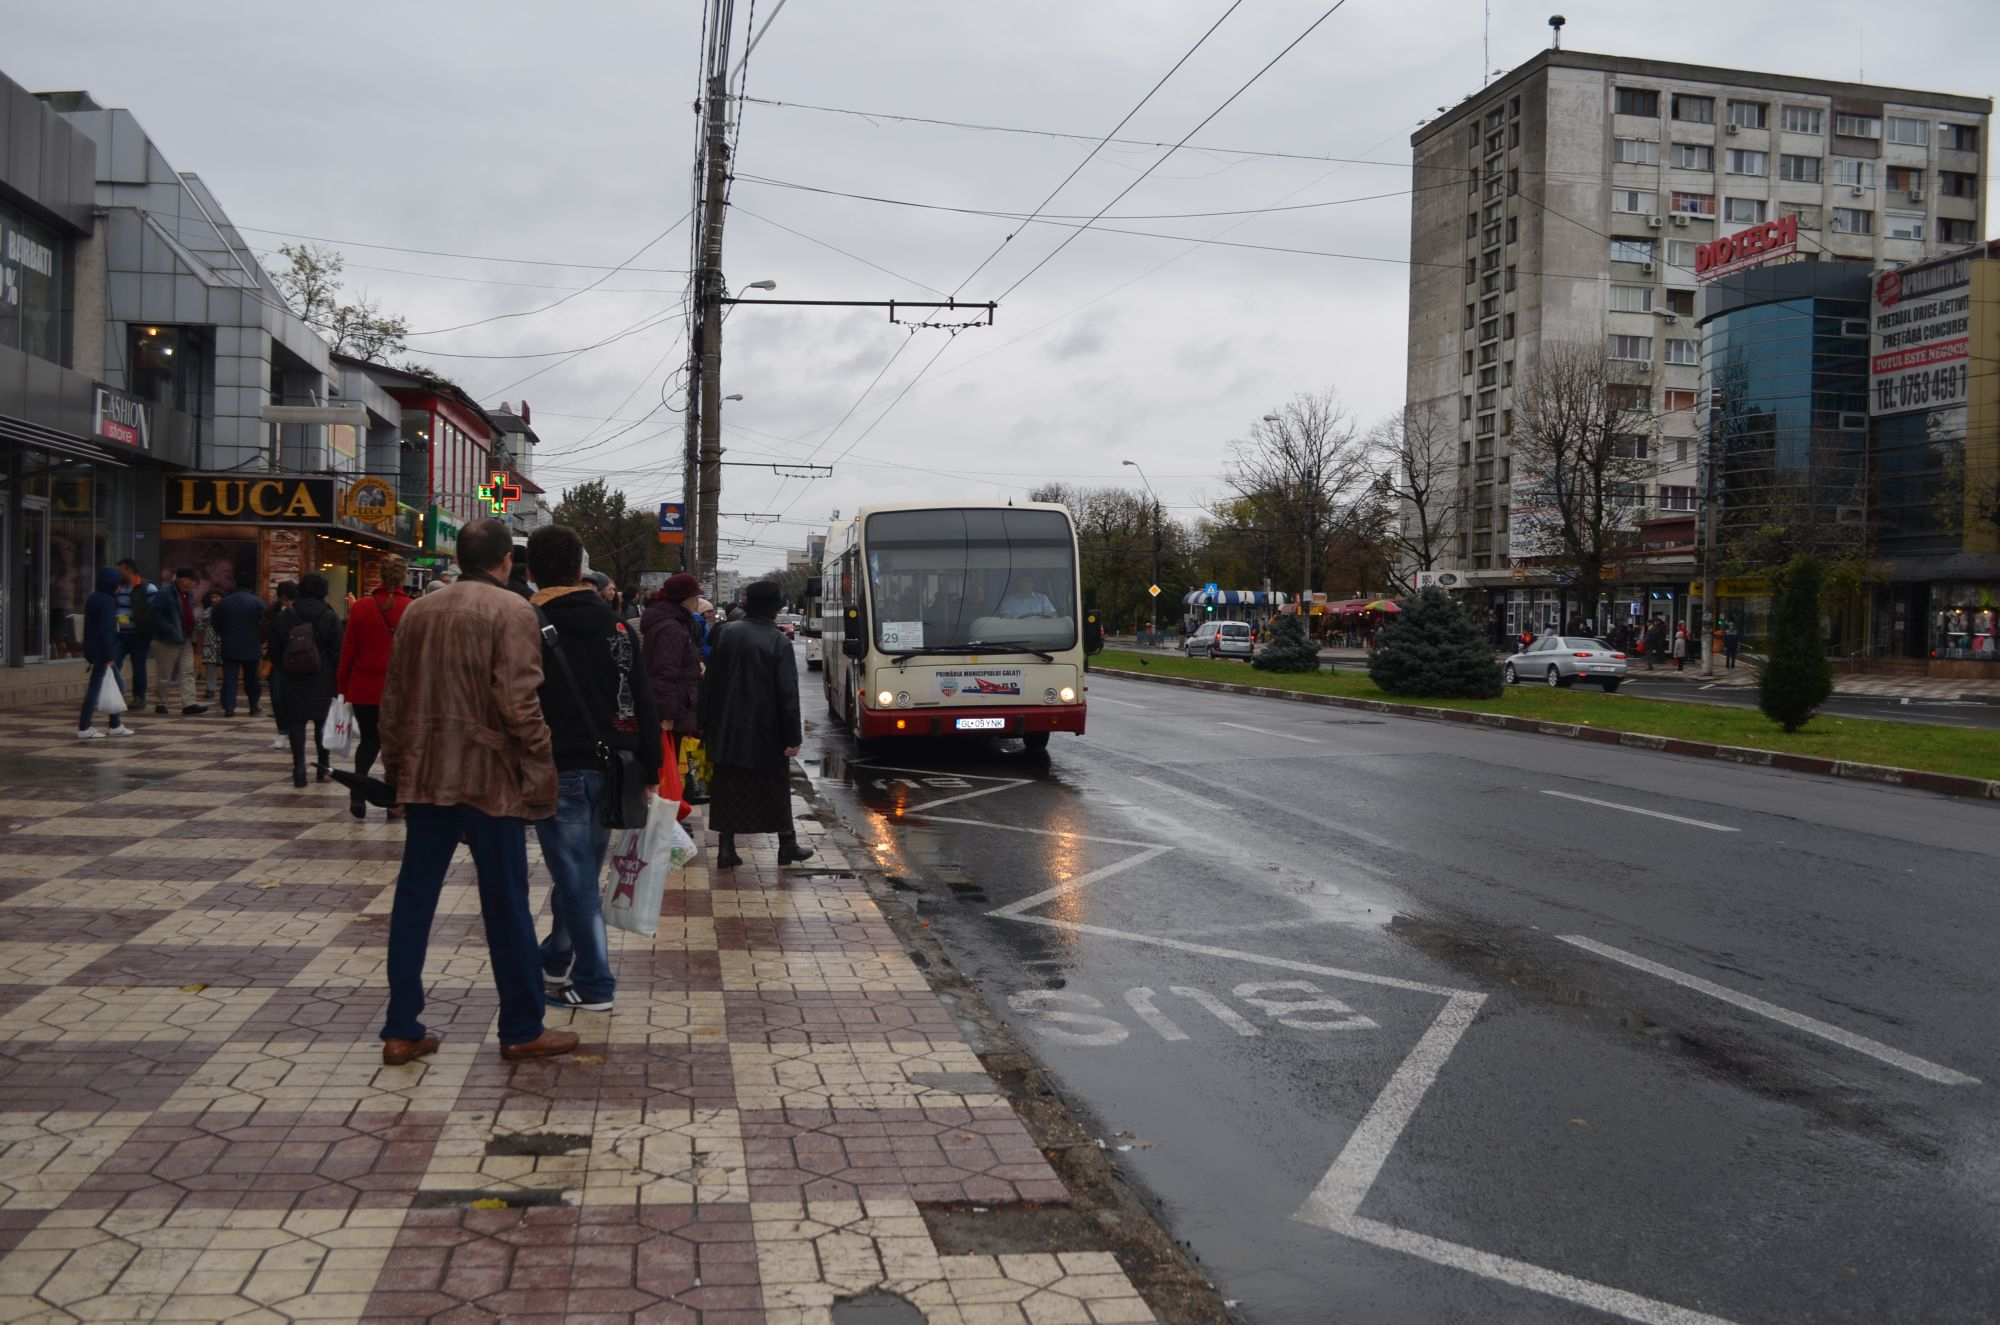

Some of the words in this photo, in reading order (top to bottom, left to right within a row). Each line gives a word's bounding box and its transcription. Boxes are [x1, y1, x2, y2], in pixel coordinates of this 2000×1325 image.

[9, 230, 52, 277] BARBATI
[1696, 214, 1797, 272] DIOTECH
[1902, 262, 1954, 296] APROXIMATIV
[1877, 310, 1912, 330] PRETABIL
[1913, 304, 1937, 322] ORICE
[1876, 355, 1903, 371] TOTUL
[1904, 350, 1927, 365] ESTE
[1899, 370, 1929, 407] 0753
[1931, 365, 1957, 402] 459
[96, 388, 151, 449] FASHION
[109, 423, 133, 443] store
[177, 479, 320, 517] LUCA
[358, 507, 383, 515] LUCA
[884, 633, 899, 643] 29
[961, 720, 972, 728] GL
[974, 719, 985, 727] 09
[986, 719, 1003, 727] YNK
[1007, 979, 1381, 1046] BUS
